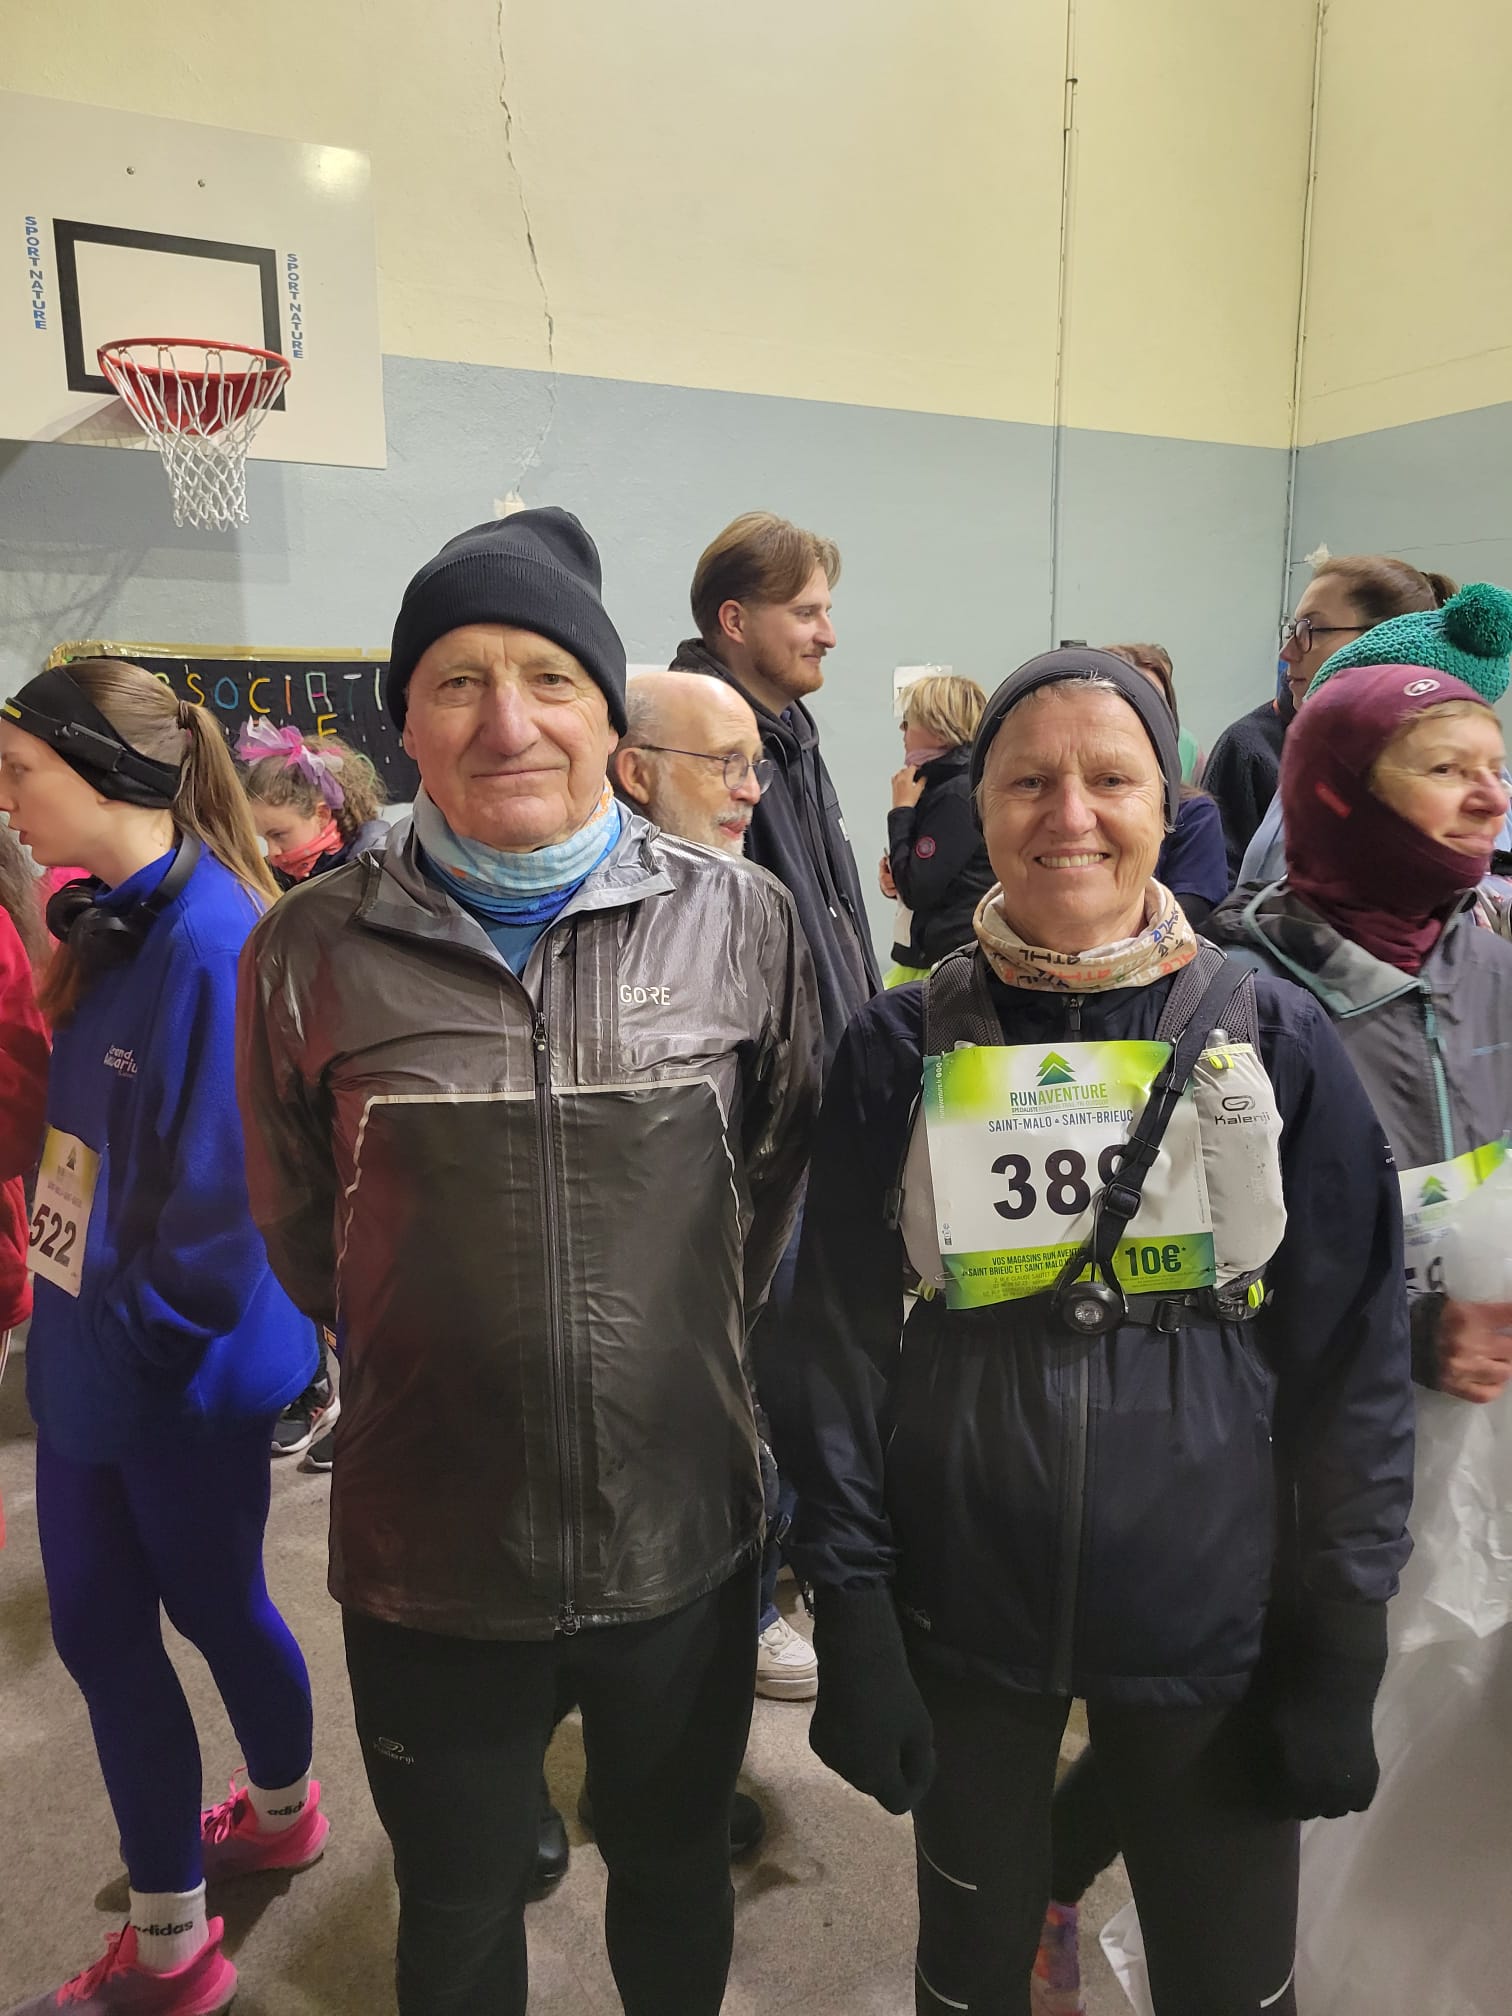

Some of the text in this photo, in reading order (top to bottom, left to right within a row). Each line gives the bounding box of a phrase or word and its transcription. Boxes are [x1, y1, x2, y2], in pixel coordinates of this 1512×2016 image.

[25, 216, 47, 330] SPORT NATURE
[287, 253, 304, 359] SPORT NATURE
[619, 984, 671, 1006] GORE
[1010, 1082, 1108, 1107] RUNAVENTURE
[988, 1109, 1134, 1133] SAINT-MALO SAINT-BRIEUC
[1214, 1111, 1271, 1127] Kalenji
[29, 1203, 78, 1268] 522
[968, 1267, 987, 1277] SAINT
[989, 1264, 1014, 1276] BRIEUC
[1015, 1264, 1023, 1274] ET
[1024, 1262, 1043, 1273] SAINT
[1045, 1258, 1063, 1270] MALO
[992, 1256, 1006, 1266] VOS
[1007, 1252, 1042, 1265] MAGASINS
[1043, 1250, 1057, 1260] RUN
